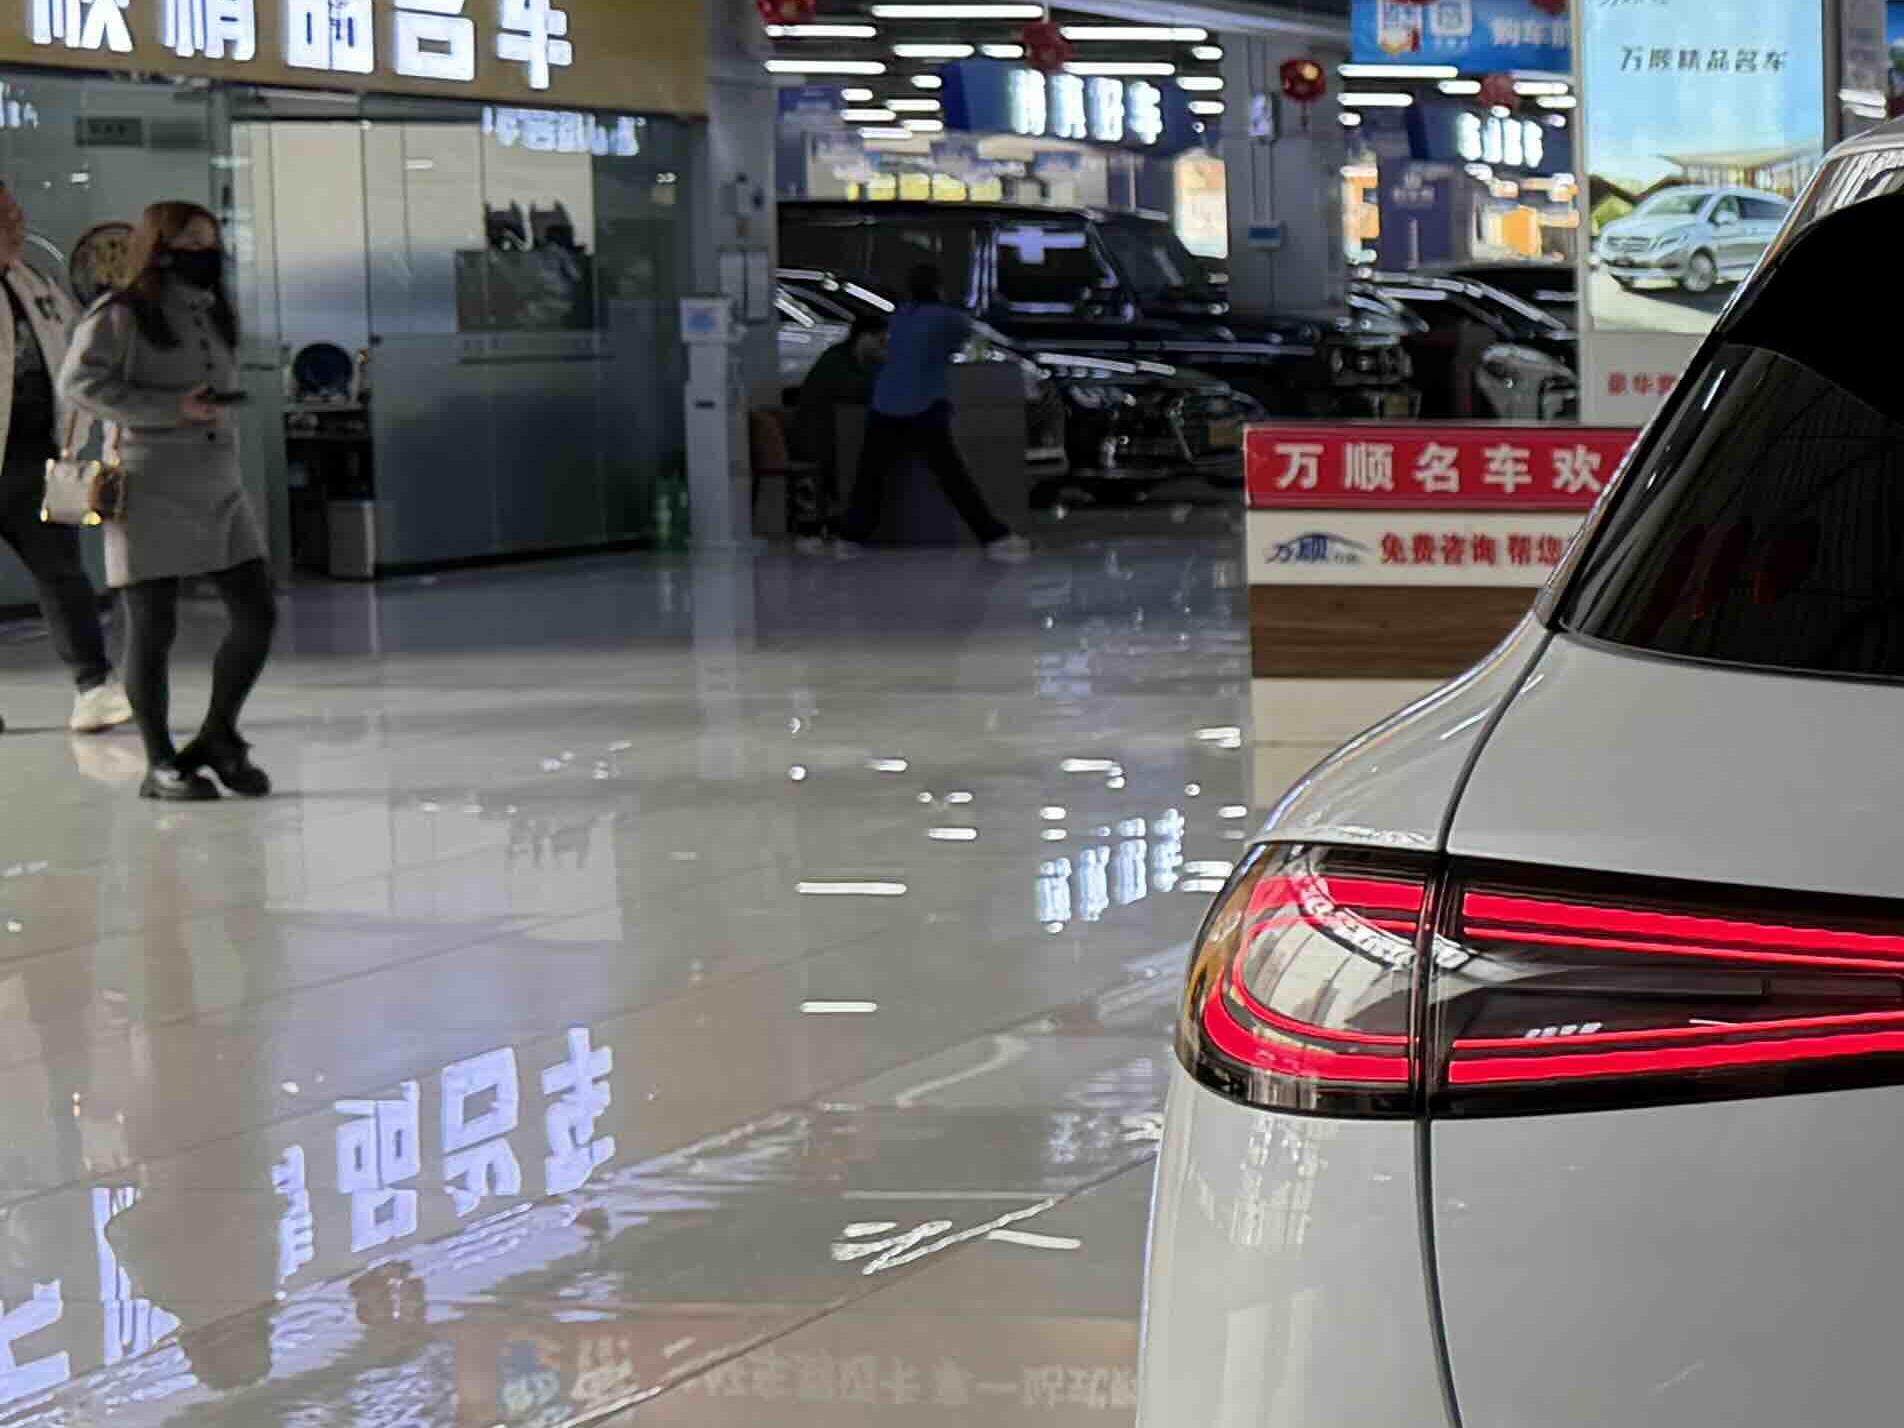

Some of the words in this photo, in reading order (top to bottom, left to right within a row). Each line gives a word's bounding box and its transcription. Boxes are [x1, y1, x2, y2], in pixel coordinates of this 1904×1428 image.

[1274, 441, 1602, 494] 万顺名车欢
[1380, 532, 1497, 566] 免费咨询
